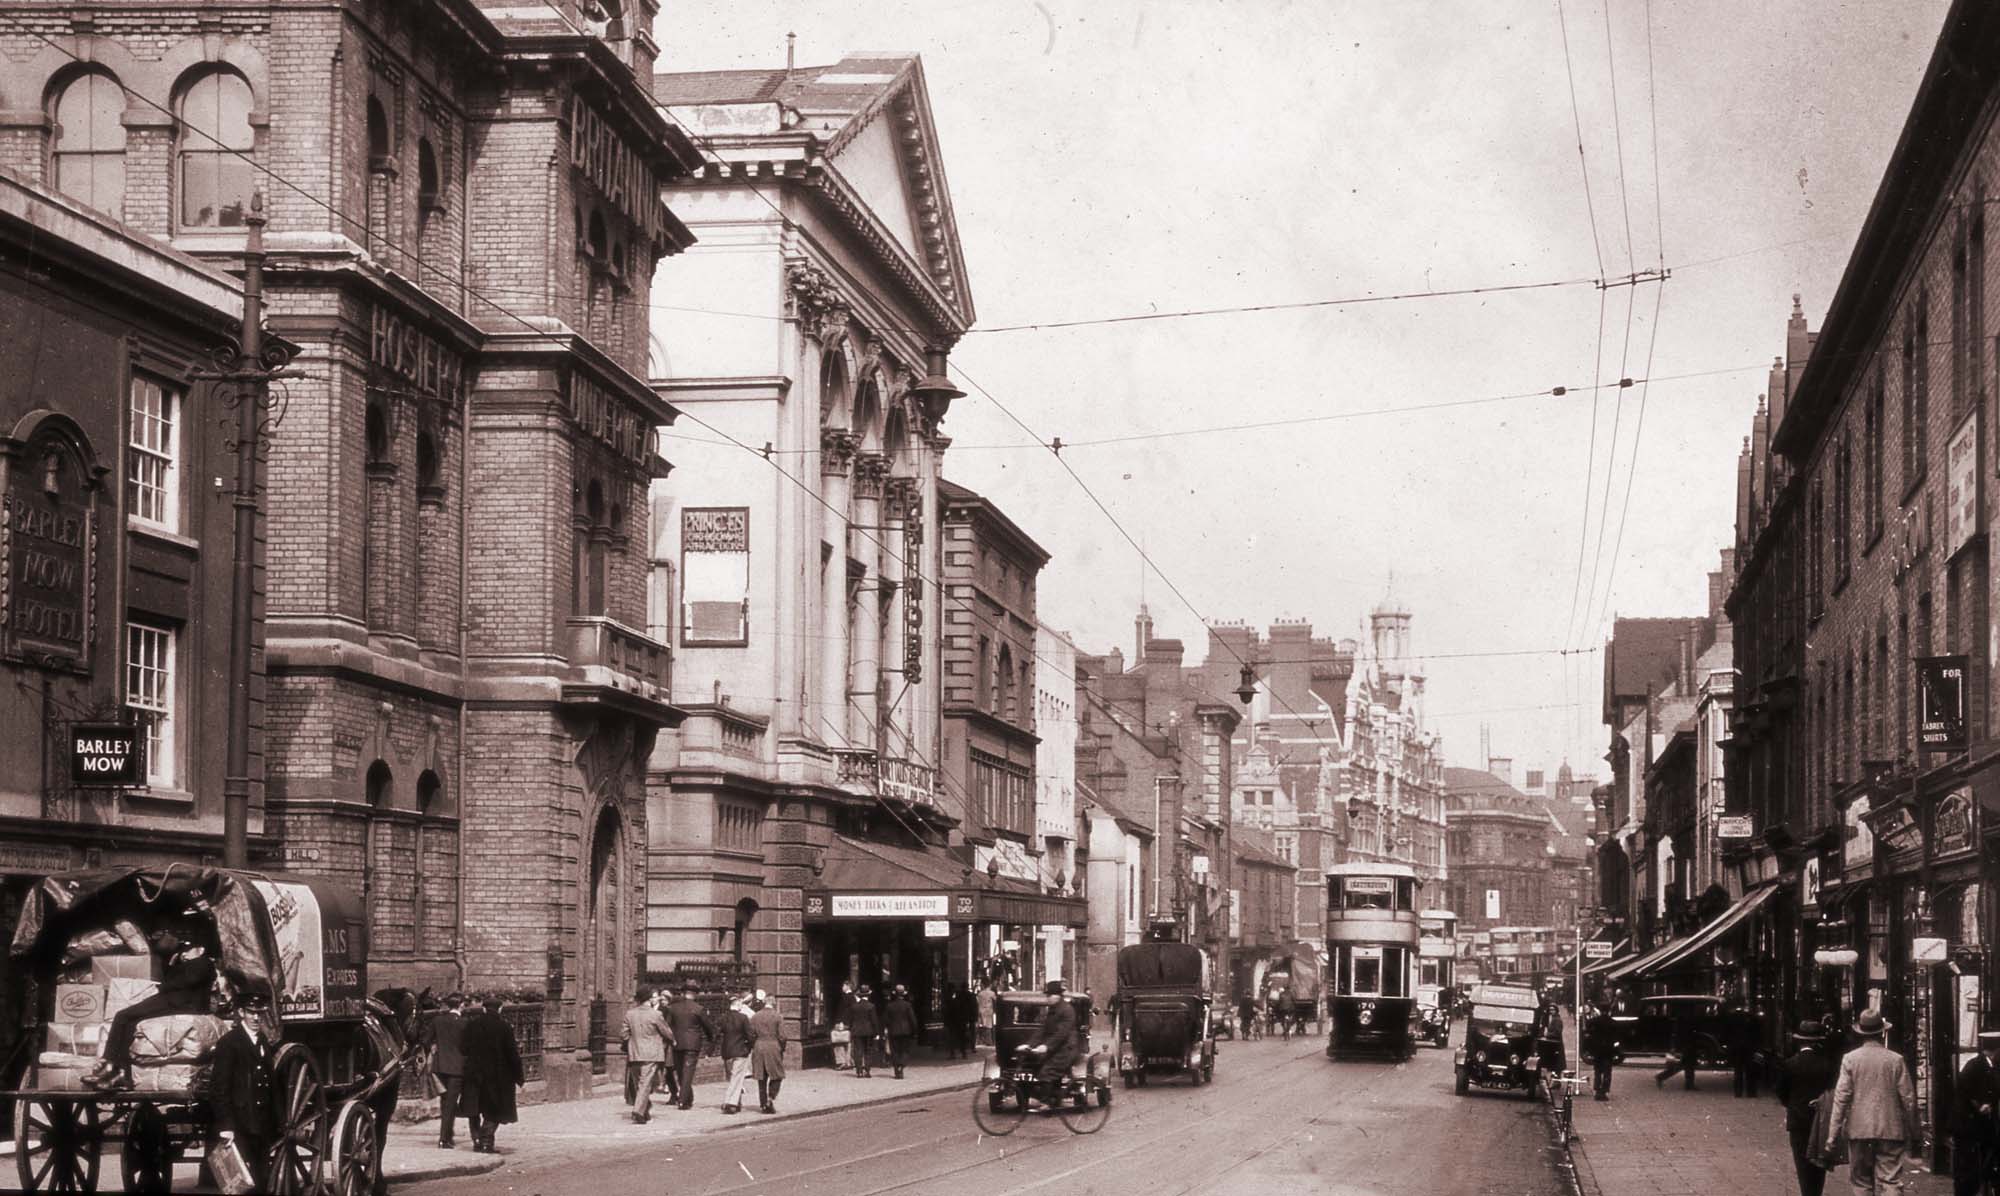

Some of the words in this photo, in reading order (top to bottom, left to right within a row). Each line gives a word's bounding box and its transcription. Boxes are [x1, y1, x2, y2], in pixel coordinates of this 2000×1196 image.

[570, 93, 665, 250] BRITANNIA
[371, 303, 462, 408] HOSIERY
[570, 368, 660, 472] UNDERWEAR
[15, 499, 84, 549] BARLEY
[23, 550, 74, 590] MOW
[15, 598, 82, 641] HOTEL
[1942, 669, 1962, 679] FOR
[76, 738, 132, 755] BARLEY
[84, 756, 125, 772] MOW
[807, 905, 824, 914] DAY
[808, 897, 823, 906] TO
[957, 904, 974, 913] DAY
[958, 897, 972, 906] TO
[326, 967, 358, 986] EXPRESS
